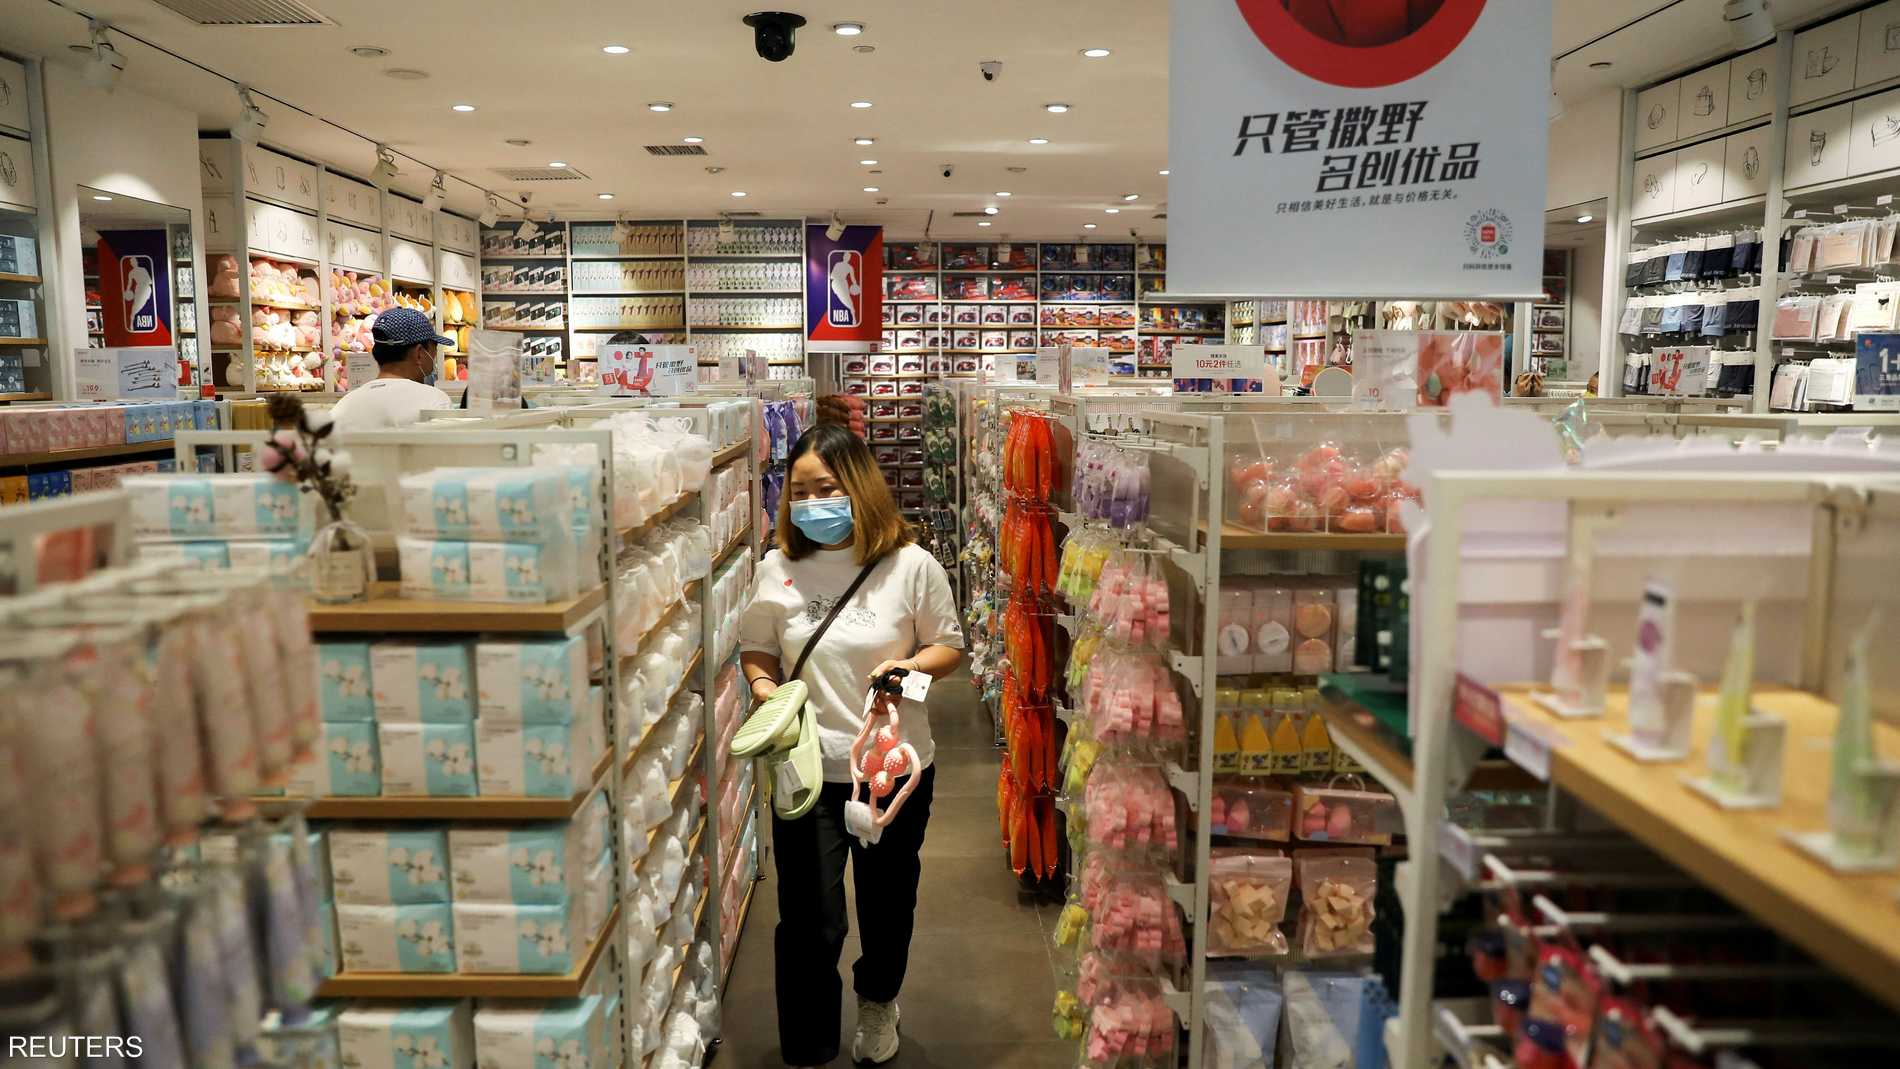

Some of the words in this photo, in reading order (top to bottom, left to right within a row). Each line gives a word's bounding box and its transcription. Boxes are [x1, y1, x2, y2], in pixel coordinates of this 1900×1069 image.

[1233, 101, 1428, 157] 只管撒野
[1315, 142, 1481, 193] 名创优品
[833, 309, 849, 322] NBA
